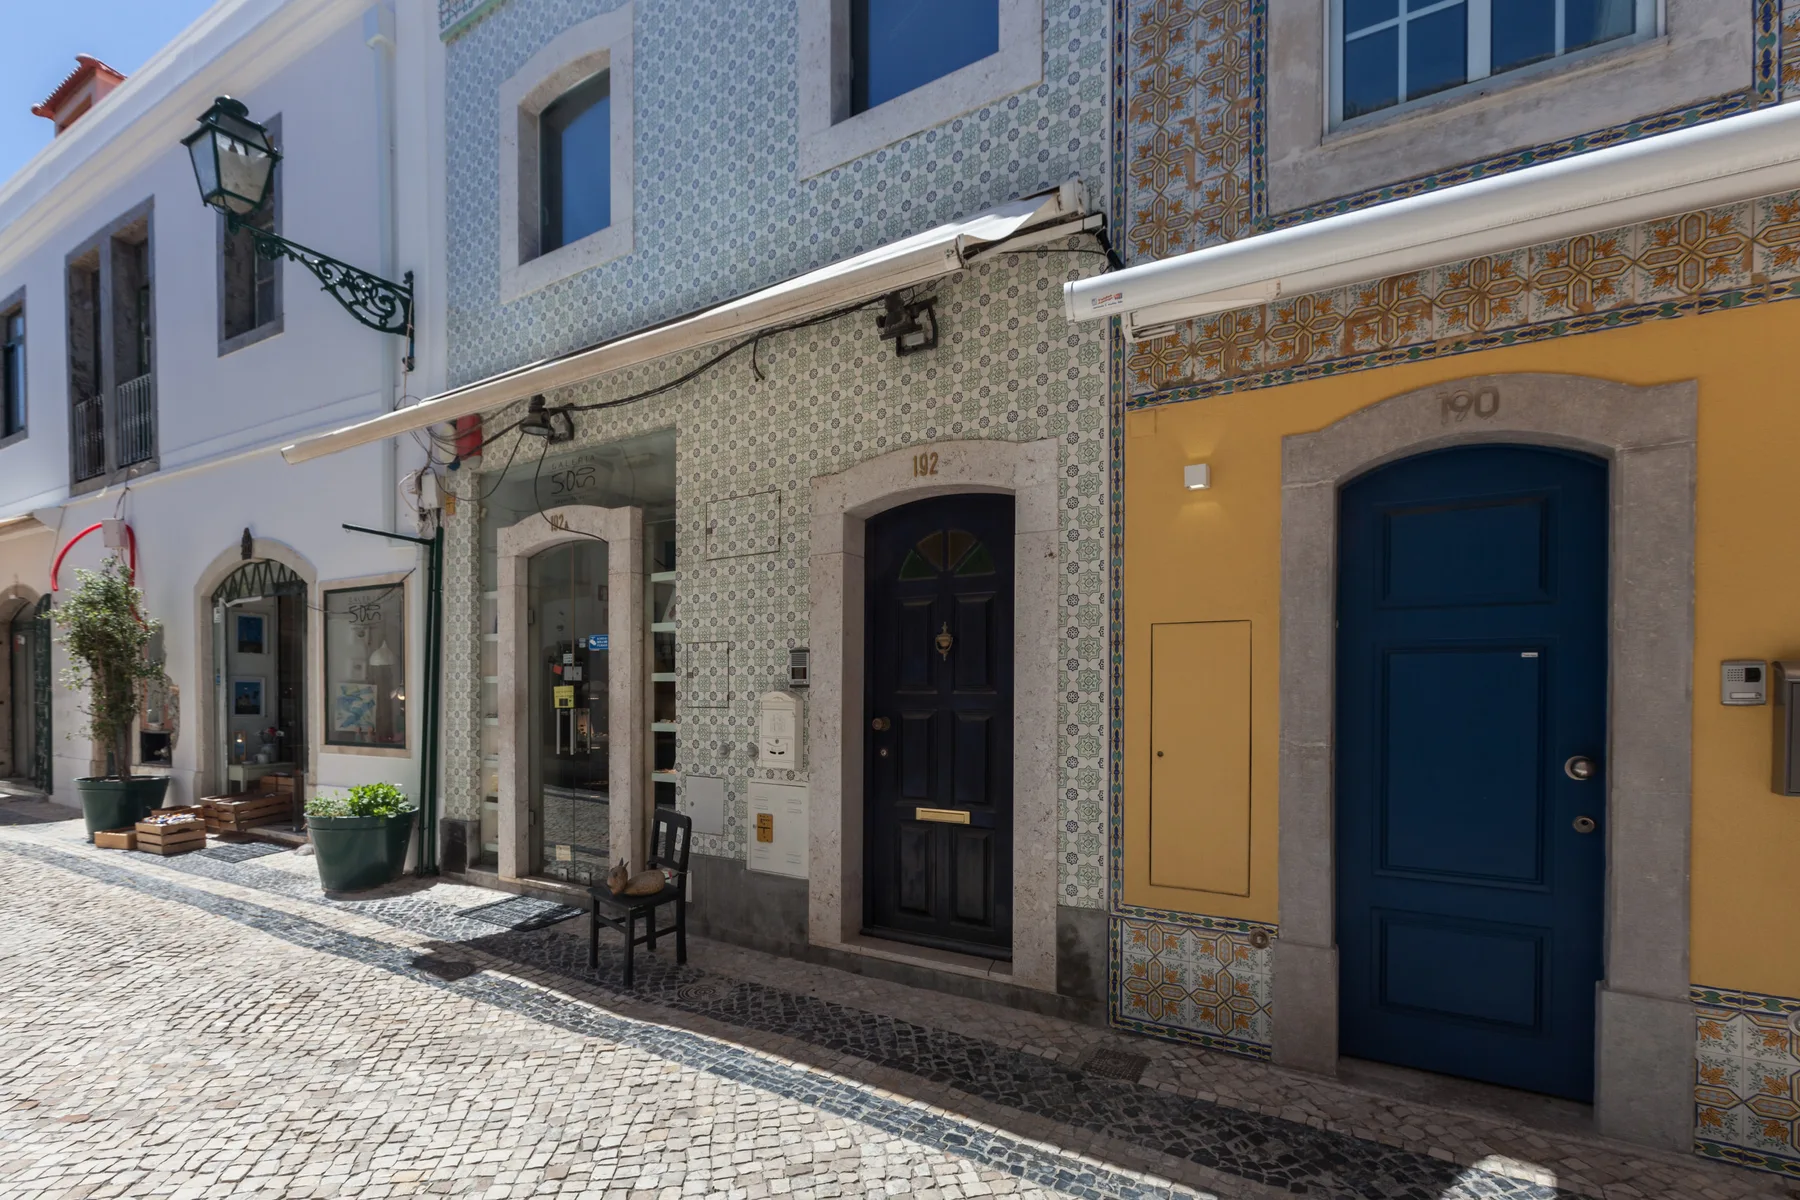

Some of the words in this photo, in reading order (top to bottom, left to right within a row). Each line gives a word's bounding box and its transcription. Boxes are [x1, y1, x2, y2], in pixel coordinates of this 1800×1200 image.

[1436, 386, 1500, 426] 190
[551, 455, 596, 470] GALERIA
[913, 451, 939, 478] 192
